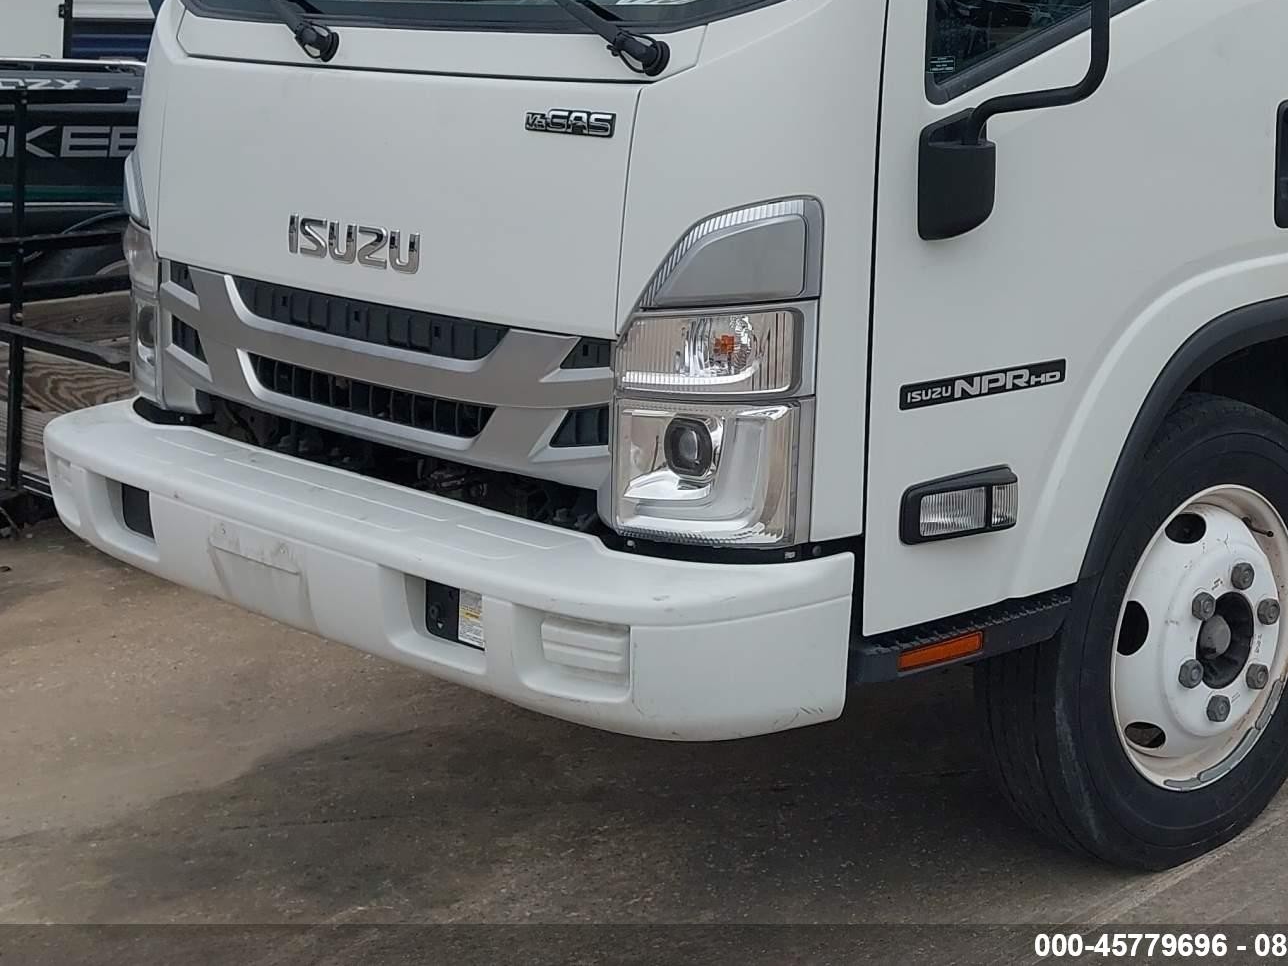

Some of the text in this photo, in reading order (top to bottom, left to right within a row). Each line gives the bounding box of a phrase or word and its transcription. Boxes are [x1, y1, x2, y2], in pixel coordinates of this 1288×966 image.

[547, 110, 612, 136] GAS
[288, 213, 421, 275] ISUZU
[906, 368, 1061, 404] ISUZU NPR HD
